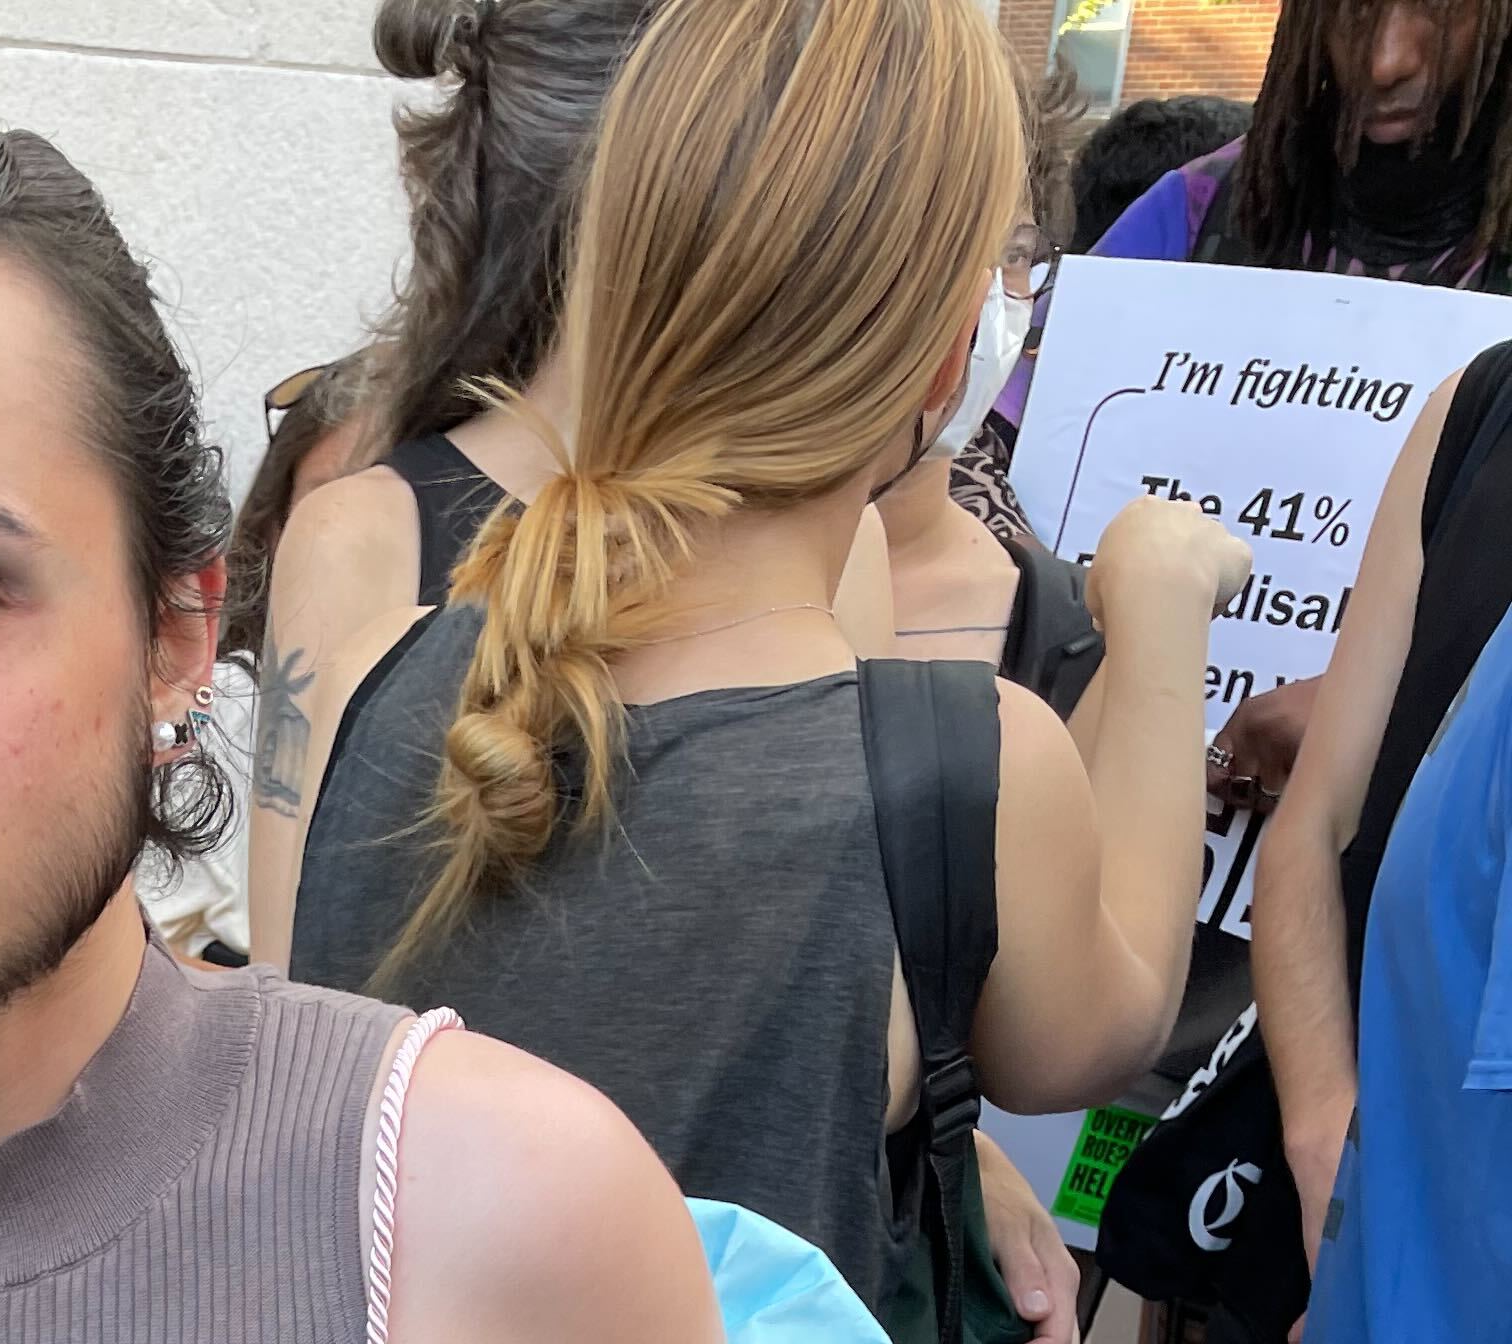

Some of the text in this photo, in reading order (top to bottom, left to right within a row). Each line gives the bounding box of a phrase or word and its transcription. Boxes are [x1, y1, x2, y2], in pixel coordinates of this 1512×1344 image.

[1151, 351, 1414, 422] I'm fighting
[1238, 487, 1352, 547] 41%
